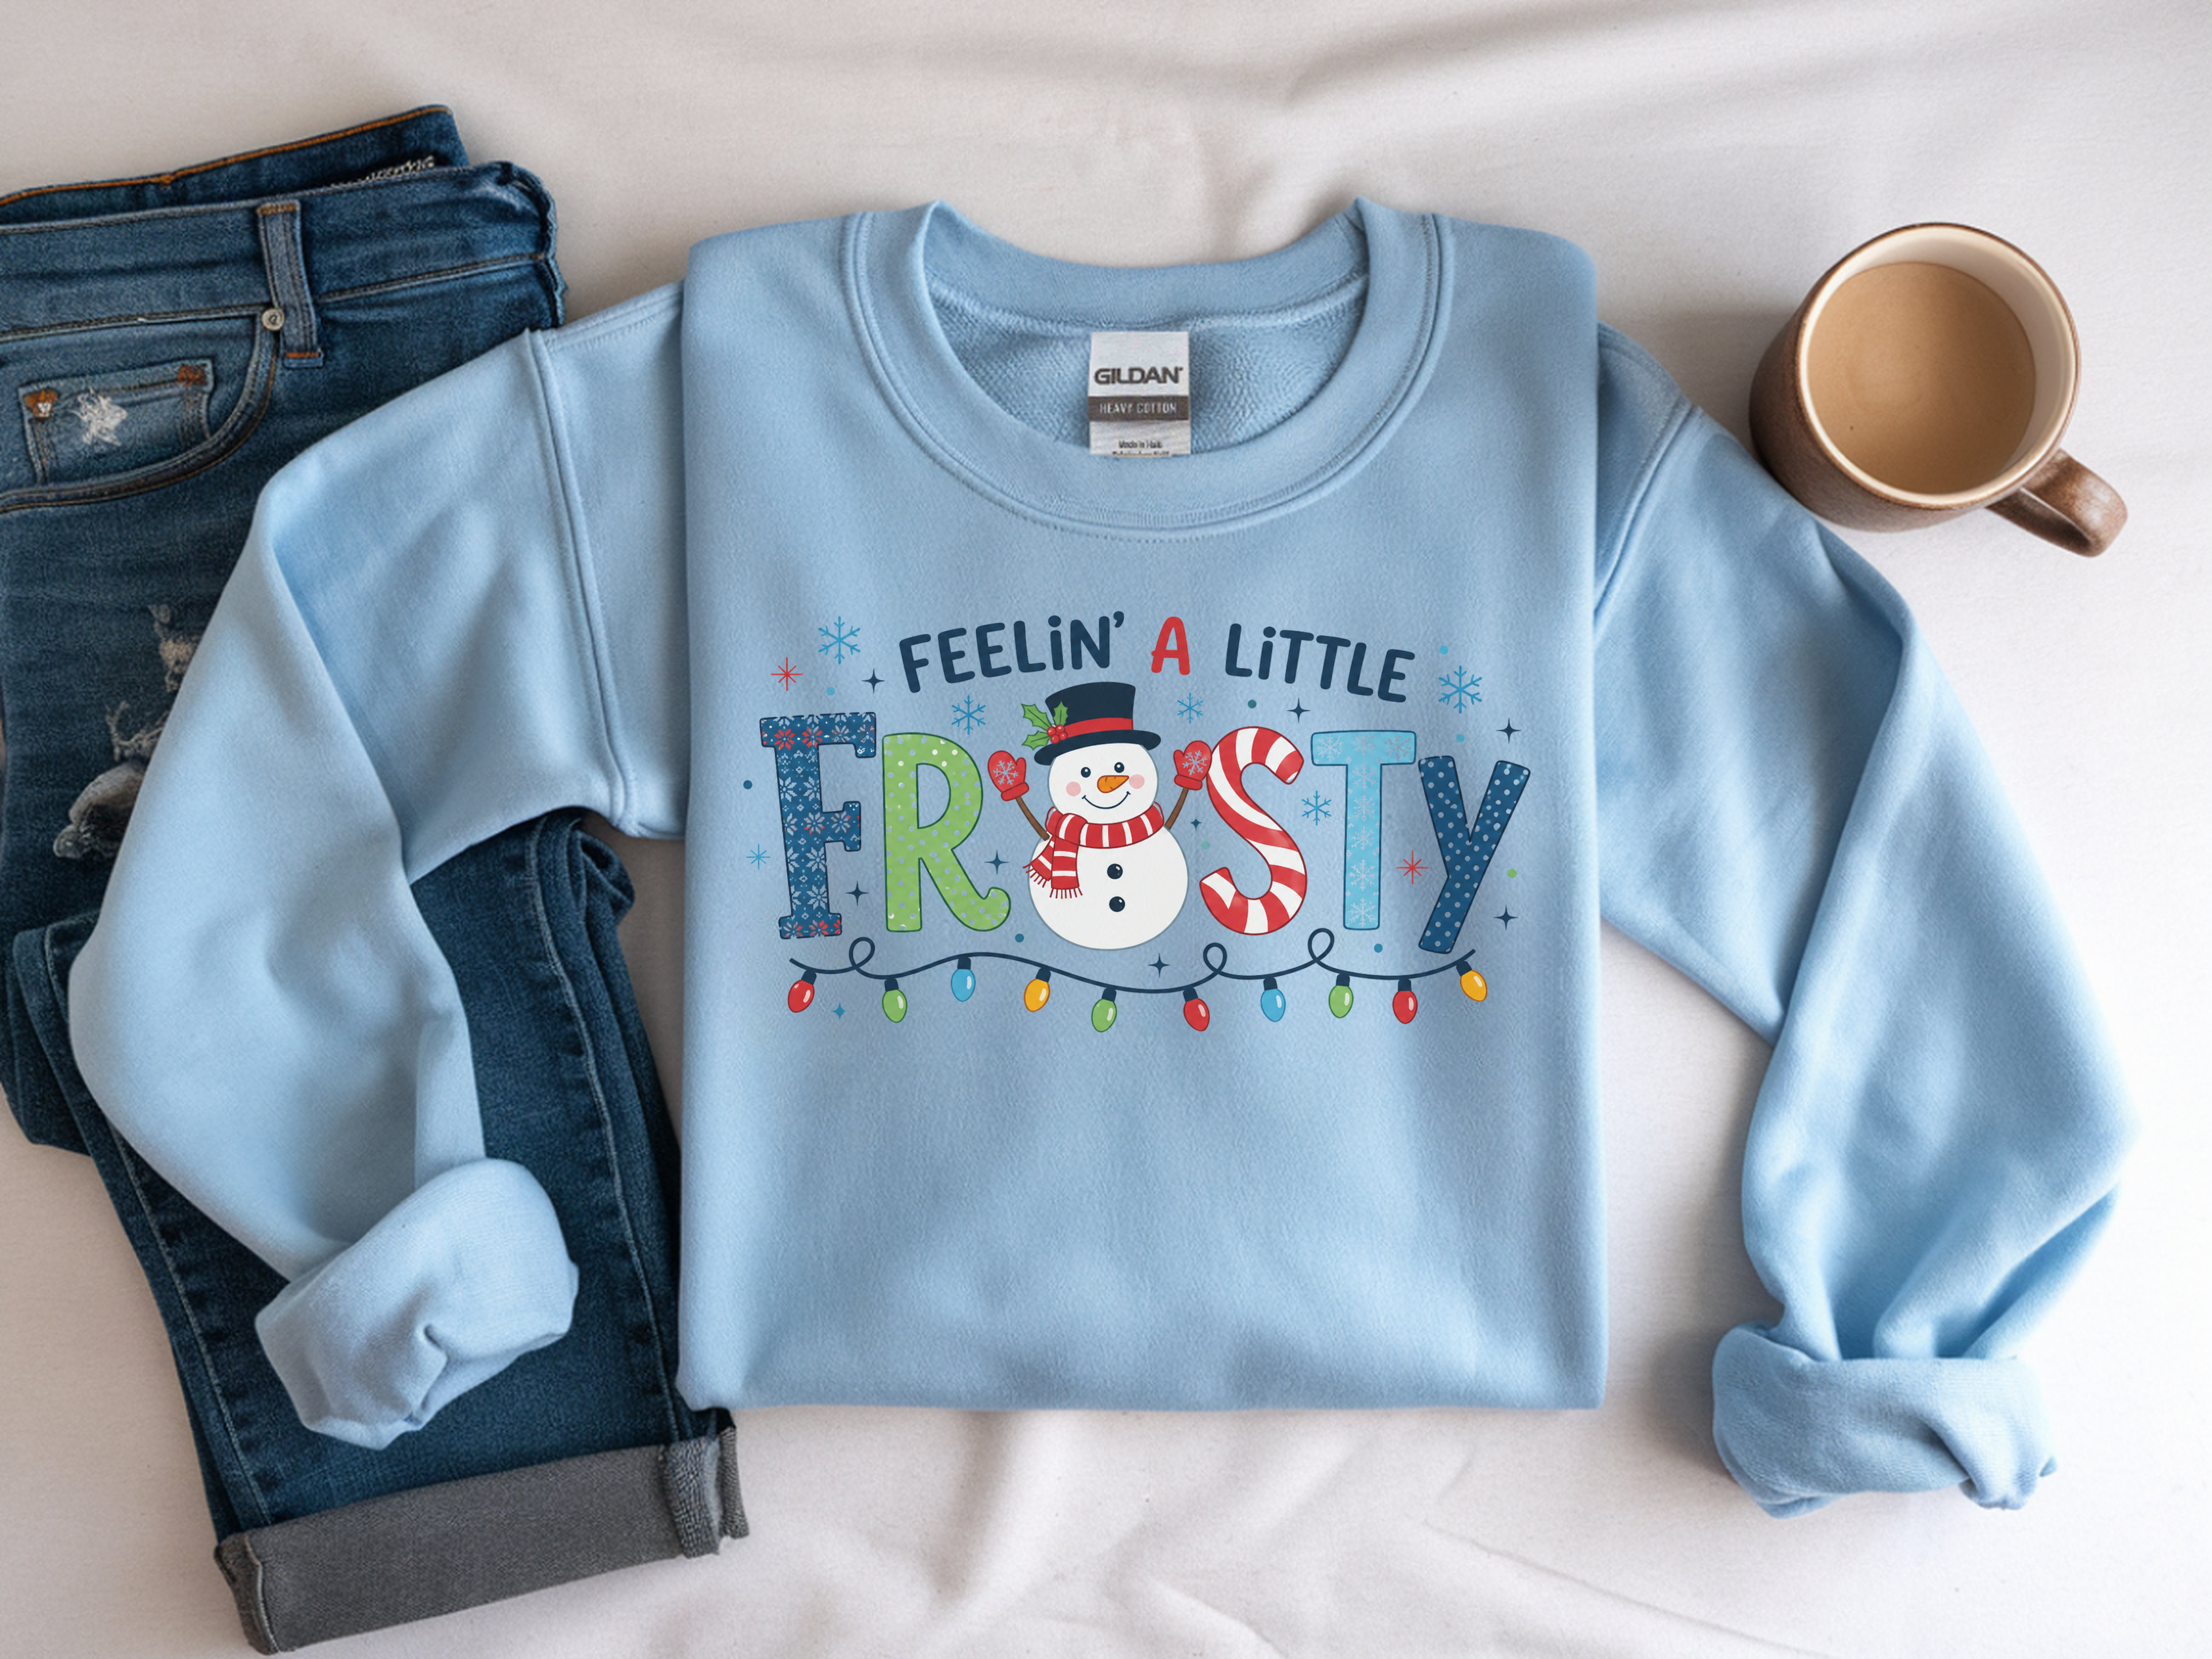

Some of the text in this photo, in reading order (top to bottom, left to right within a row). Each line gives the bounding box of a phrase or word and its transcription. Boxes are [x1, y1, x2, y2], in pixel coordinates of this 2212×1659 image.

[1094, 366, 1182, 385] GILDAN
[1100, 403, 1177, 414] HEAVY COTTON
[1151, 616, 1190, 676] A
